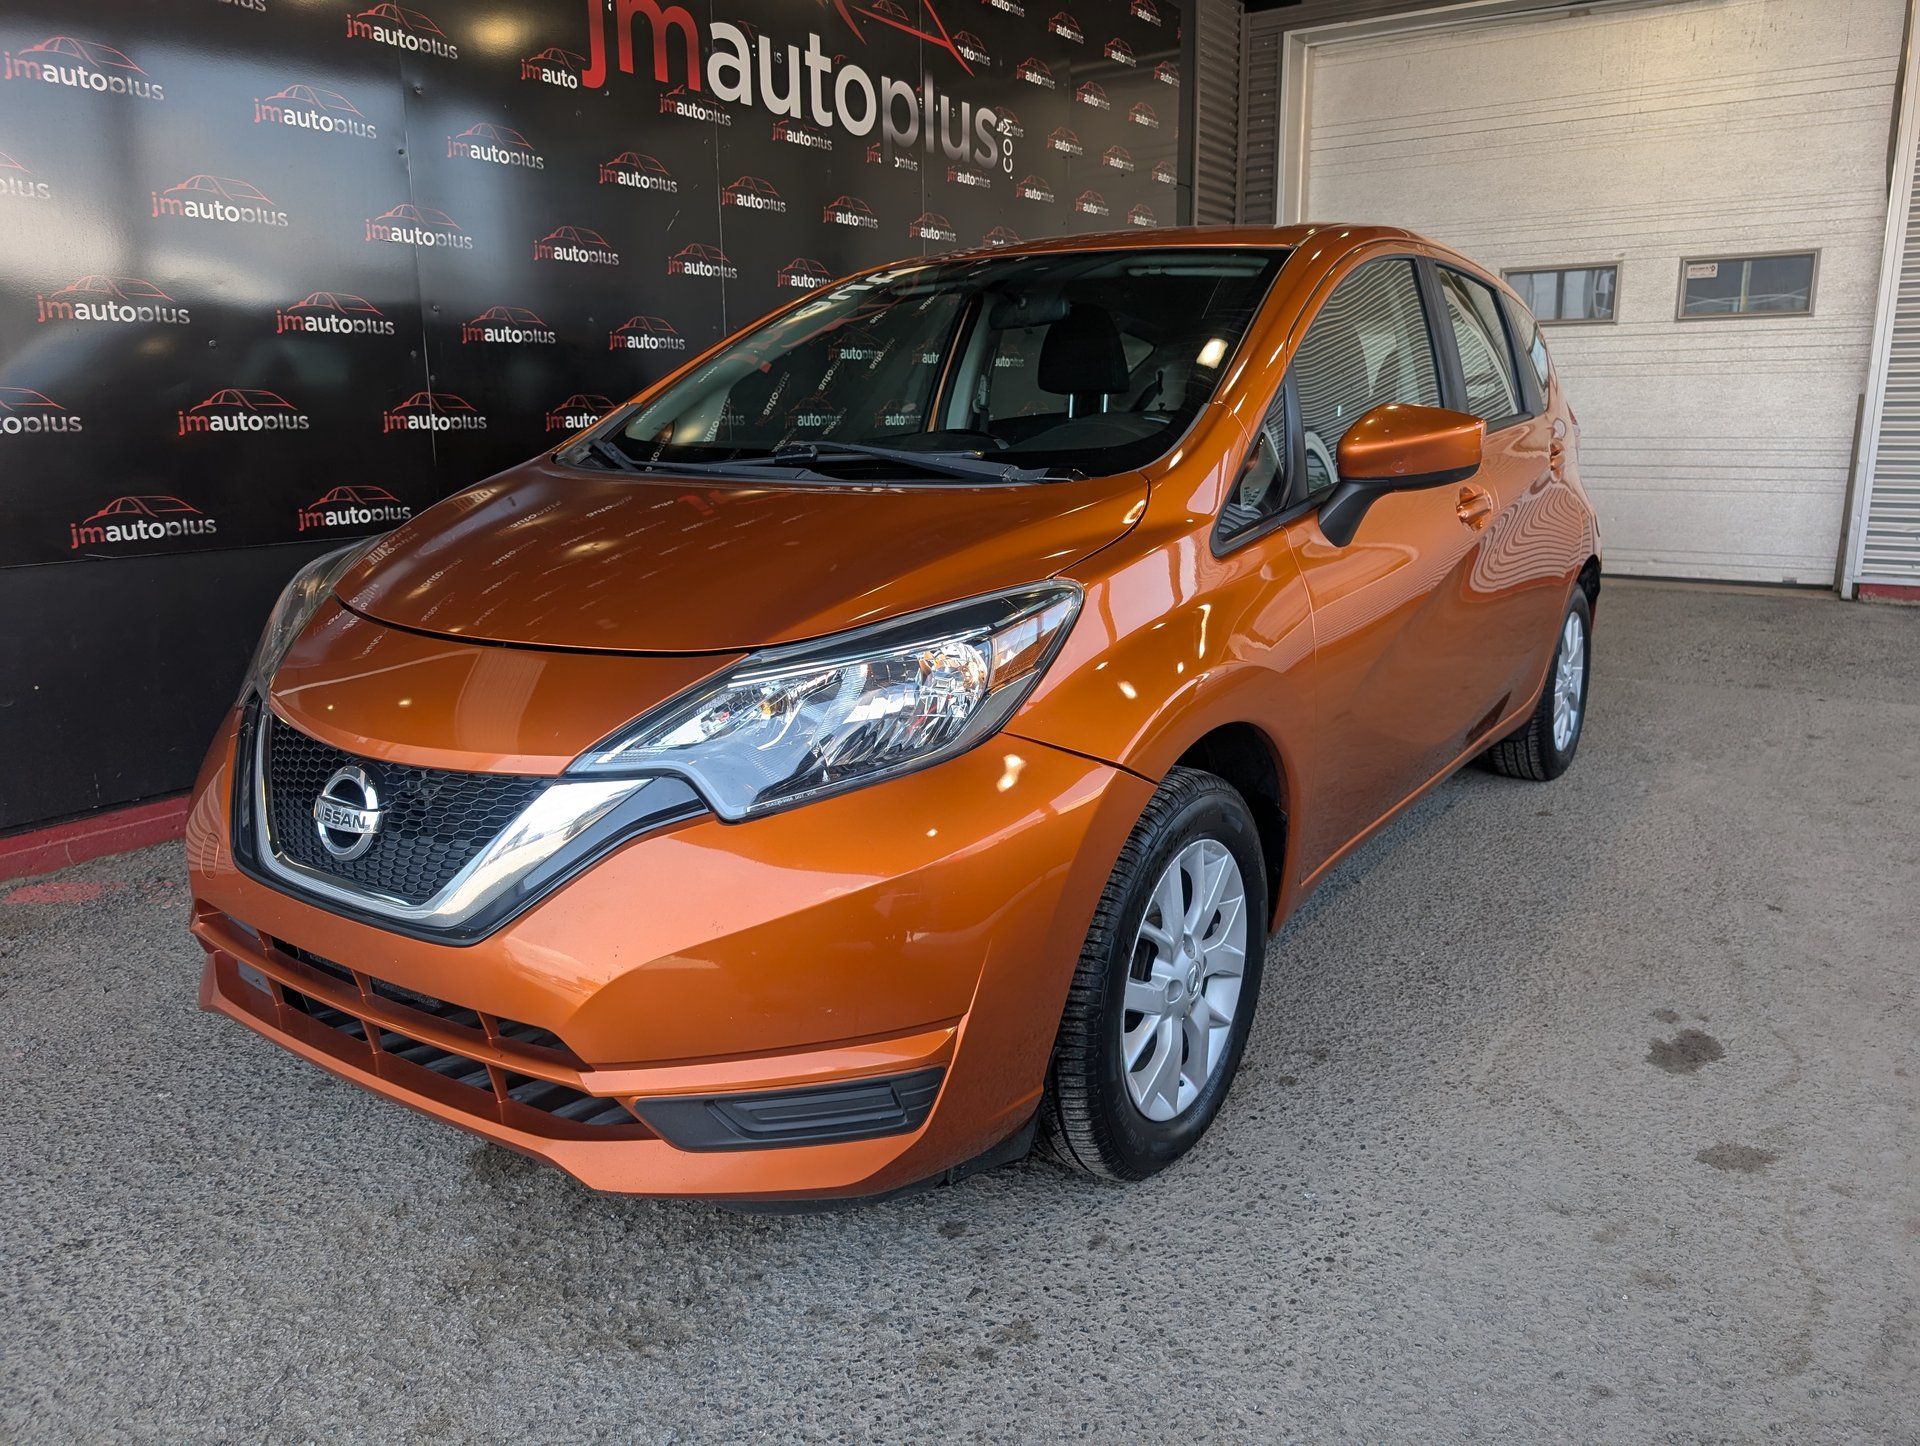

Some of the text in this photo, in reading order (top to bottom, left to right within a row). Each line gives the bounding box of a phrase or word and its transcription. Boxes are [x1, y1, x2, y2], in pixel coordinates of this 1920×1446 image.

[347, 14, 458, 60] jmautoplus
[4, 52, 165, 101] jmautoplus
[582, 0, 998, 170] jmautoplus
[254, 98, 377, 139] jmautoplus
[660, 94, 732, 127] jmautoplus
[772, 123, 833, 151] jmautoplus
[447, 136, 544, 170] jmautoplus
[599, 164, 678, 193] jmautoplus
[947, 165, 991, 188] jmautoplus
[152, 192, 288, 227] jmautoplus
[721, 190, 786, 213] jmautoplus
[823, 207, 878, 229] jmautoplus
[365, 219, 473, 250] jmautoplus
[909, 223, 957, 243] jmautoplus
[533, 240, 620, 266] jmautoplus
[668, 257, 737, 279] jmautoplus
[37, 296, 190, 324] jmautoplus
[276, 309, 395, 336] jmautoplus
[462, 323, 556, 345] jmautoplus
[609, 332, 685, 351] jmautoplus
[0, 413, 83, 434] oplus
[178, 410, 310, 436] jmautoplus
[383, 411, 487, 433] jmautoplus
[70, 515, 217, 548] jmautoplus
[299, 505, 412, 532] jmautoplus
[317, 803, 366, 829] NISSAN
